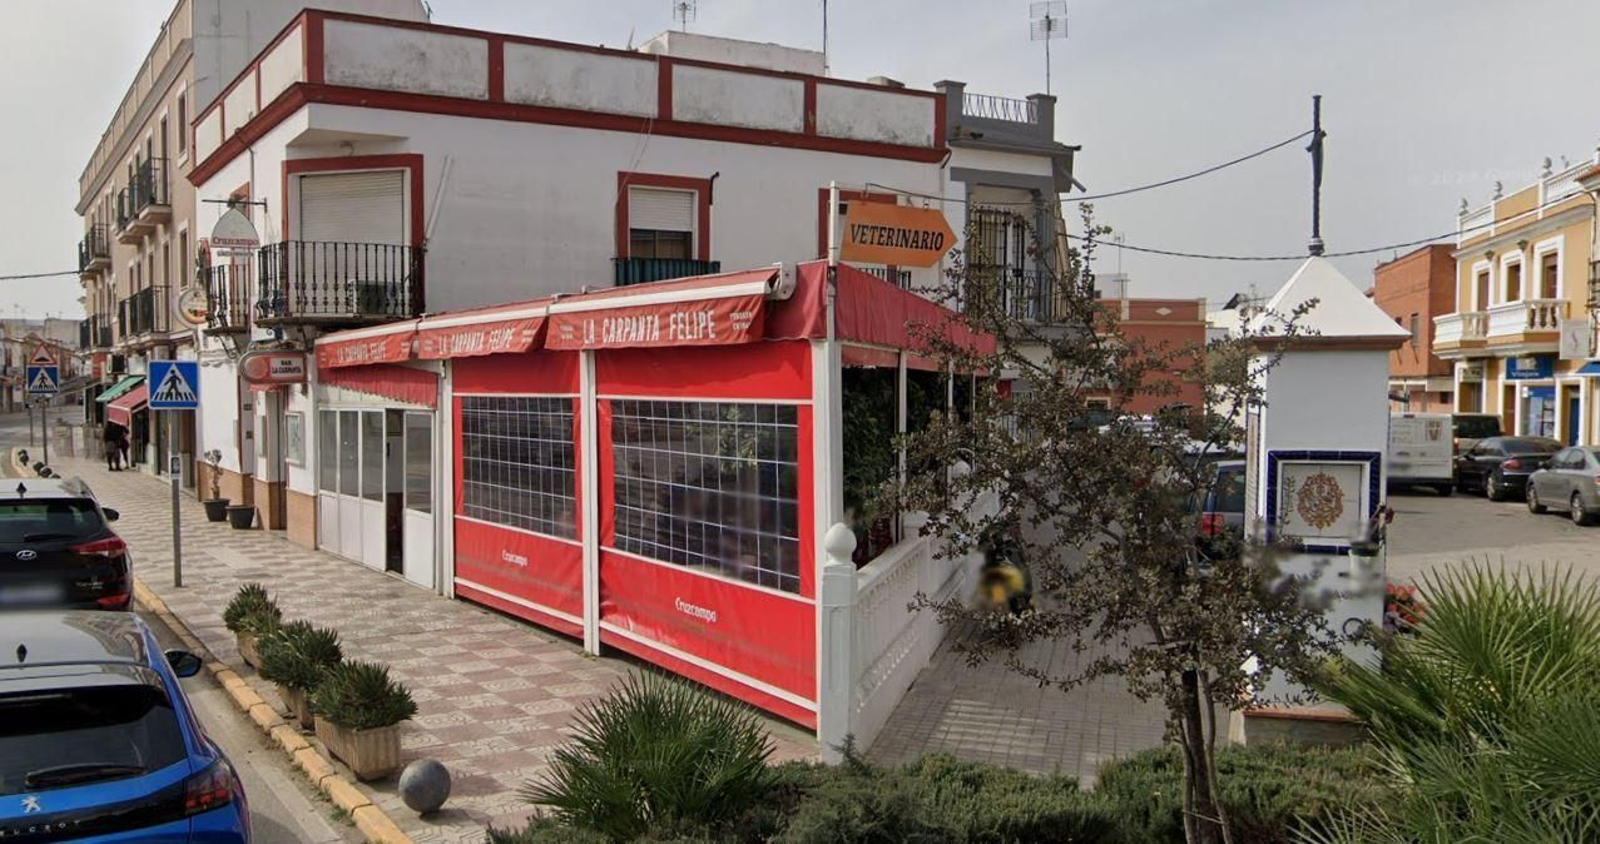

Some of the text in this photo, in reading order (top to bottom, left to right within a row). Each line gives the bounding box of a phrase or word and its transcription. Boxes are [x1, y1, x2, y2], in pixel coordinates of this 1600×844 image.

[850, 223, 945, 251] VETERINARIO
[583, 310, 716, 344] LA CARPANTA FELIPE
[439, 334, 447, 354] LA
[450, 331, 485, 353] CARPANTA
[488, 328, 516, 350] FELIPE
[501, 549, 528, 567] Cruzcampo
[675, 596, 717, 622] Cruzcampo
